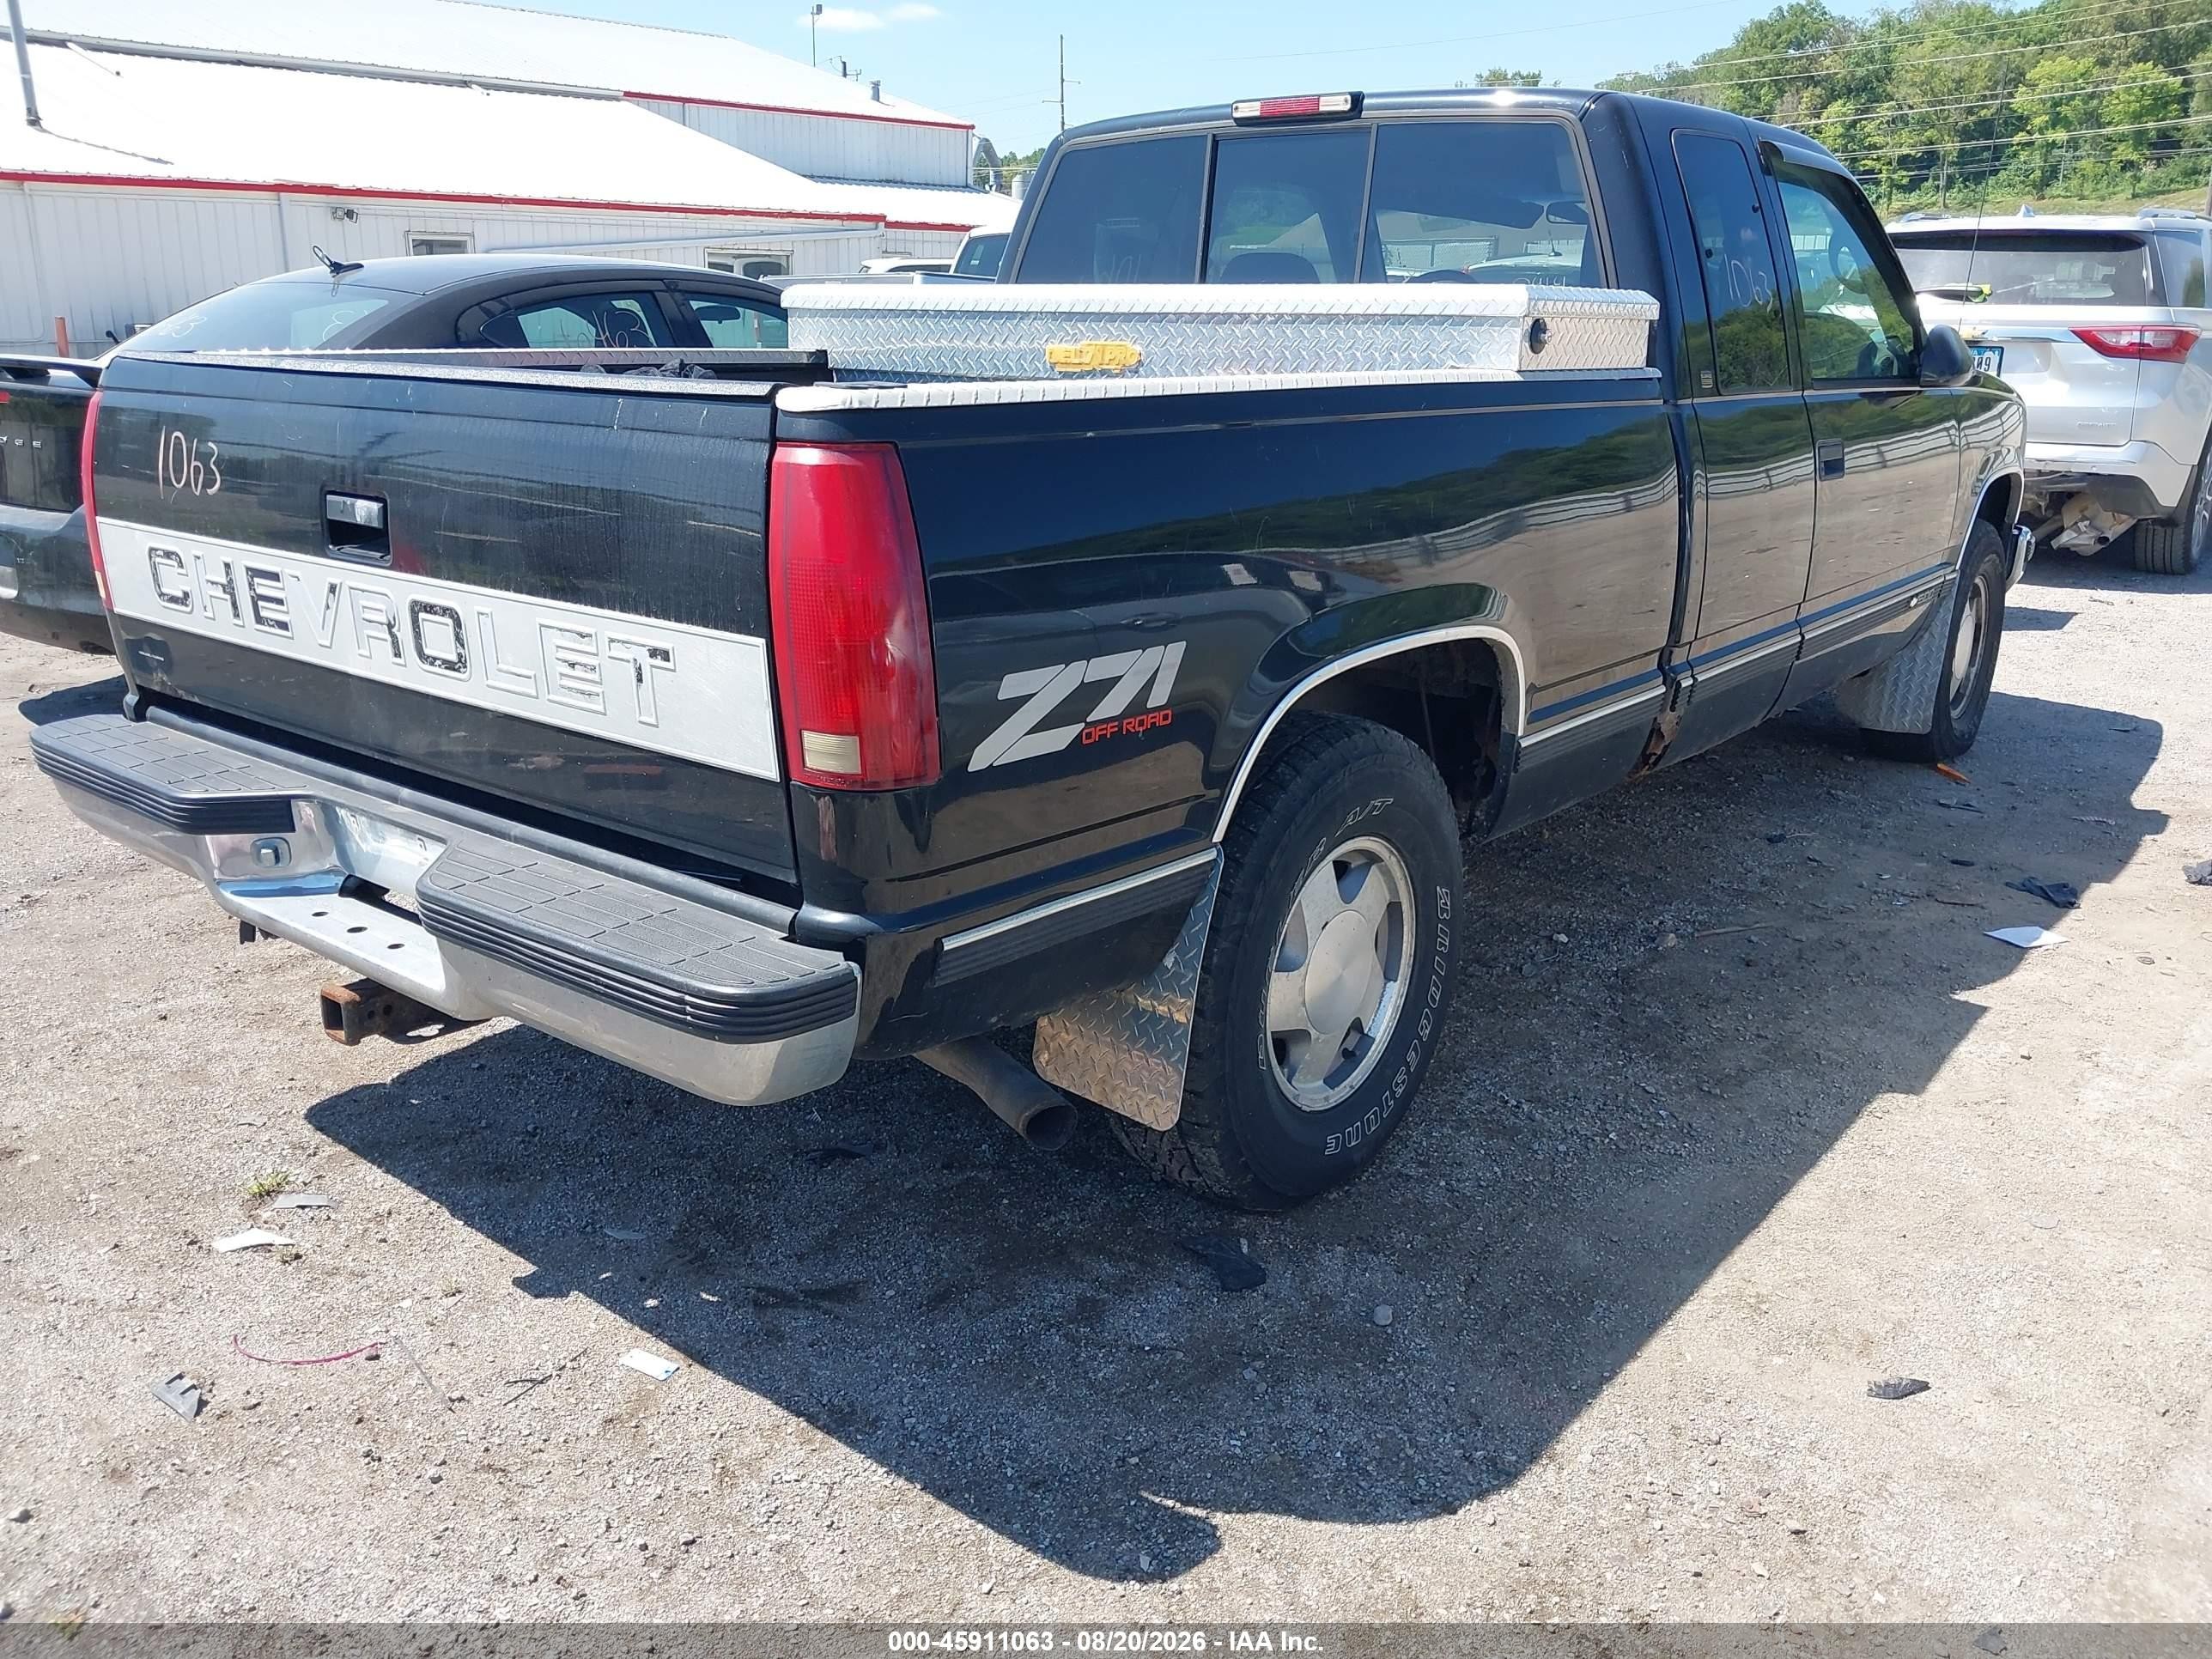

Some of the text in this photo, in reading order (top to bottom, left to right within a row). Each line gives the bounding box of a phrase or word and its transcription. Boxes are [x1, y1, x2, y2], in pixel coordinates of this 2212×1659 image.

[1723, 253, 1773, 313] 1063
[158, 425, 221, 500] 1063
[147, 543, 678, 728] CHEVROLET
[967, 640, 1188, 773] Z71
[1081, 708, 1174, 747] OFF ROAD
[1334, 797, 1395, 838] A/T
[1323, 884, 1450, 1156] BRIDGESTONE
